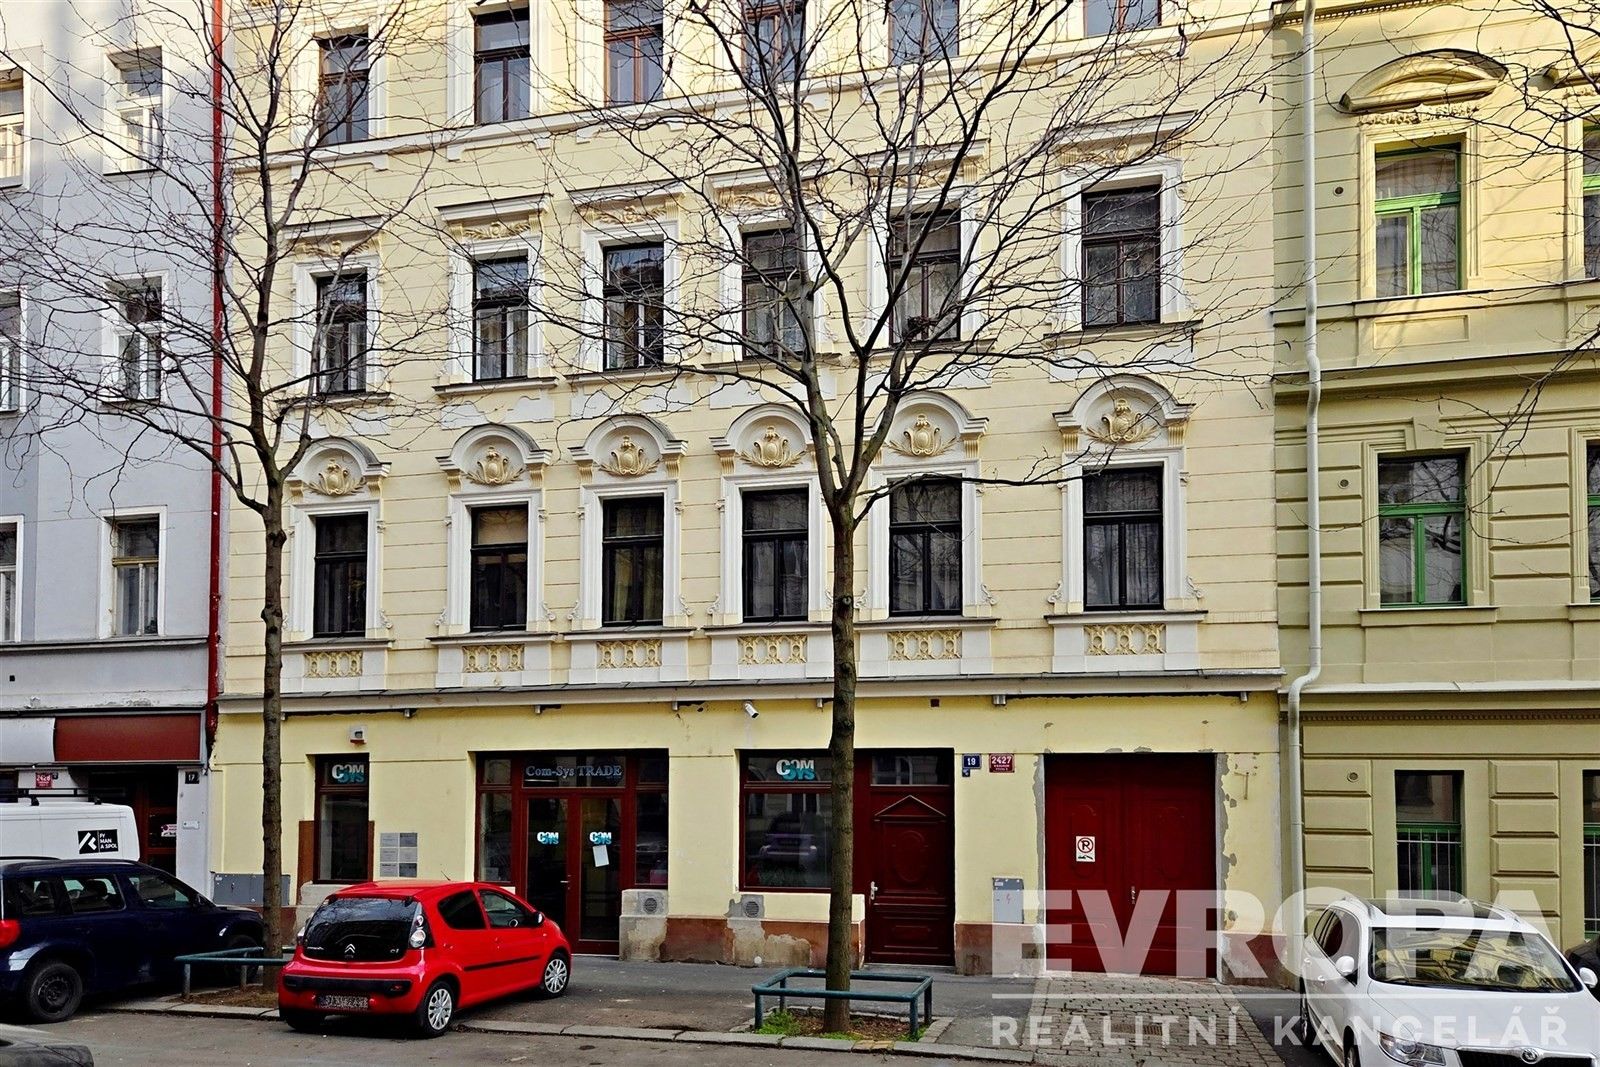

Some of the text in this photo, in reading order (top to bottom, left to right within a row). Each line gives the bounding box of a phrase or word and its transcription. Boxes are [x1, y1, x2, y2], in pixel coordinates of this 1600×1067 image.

[967, 757, 976, 766] 19
[991, 756, 1012, 765] 2427
[525, 765, 622, 779] Com-Sys TRADE
